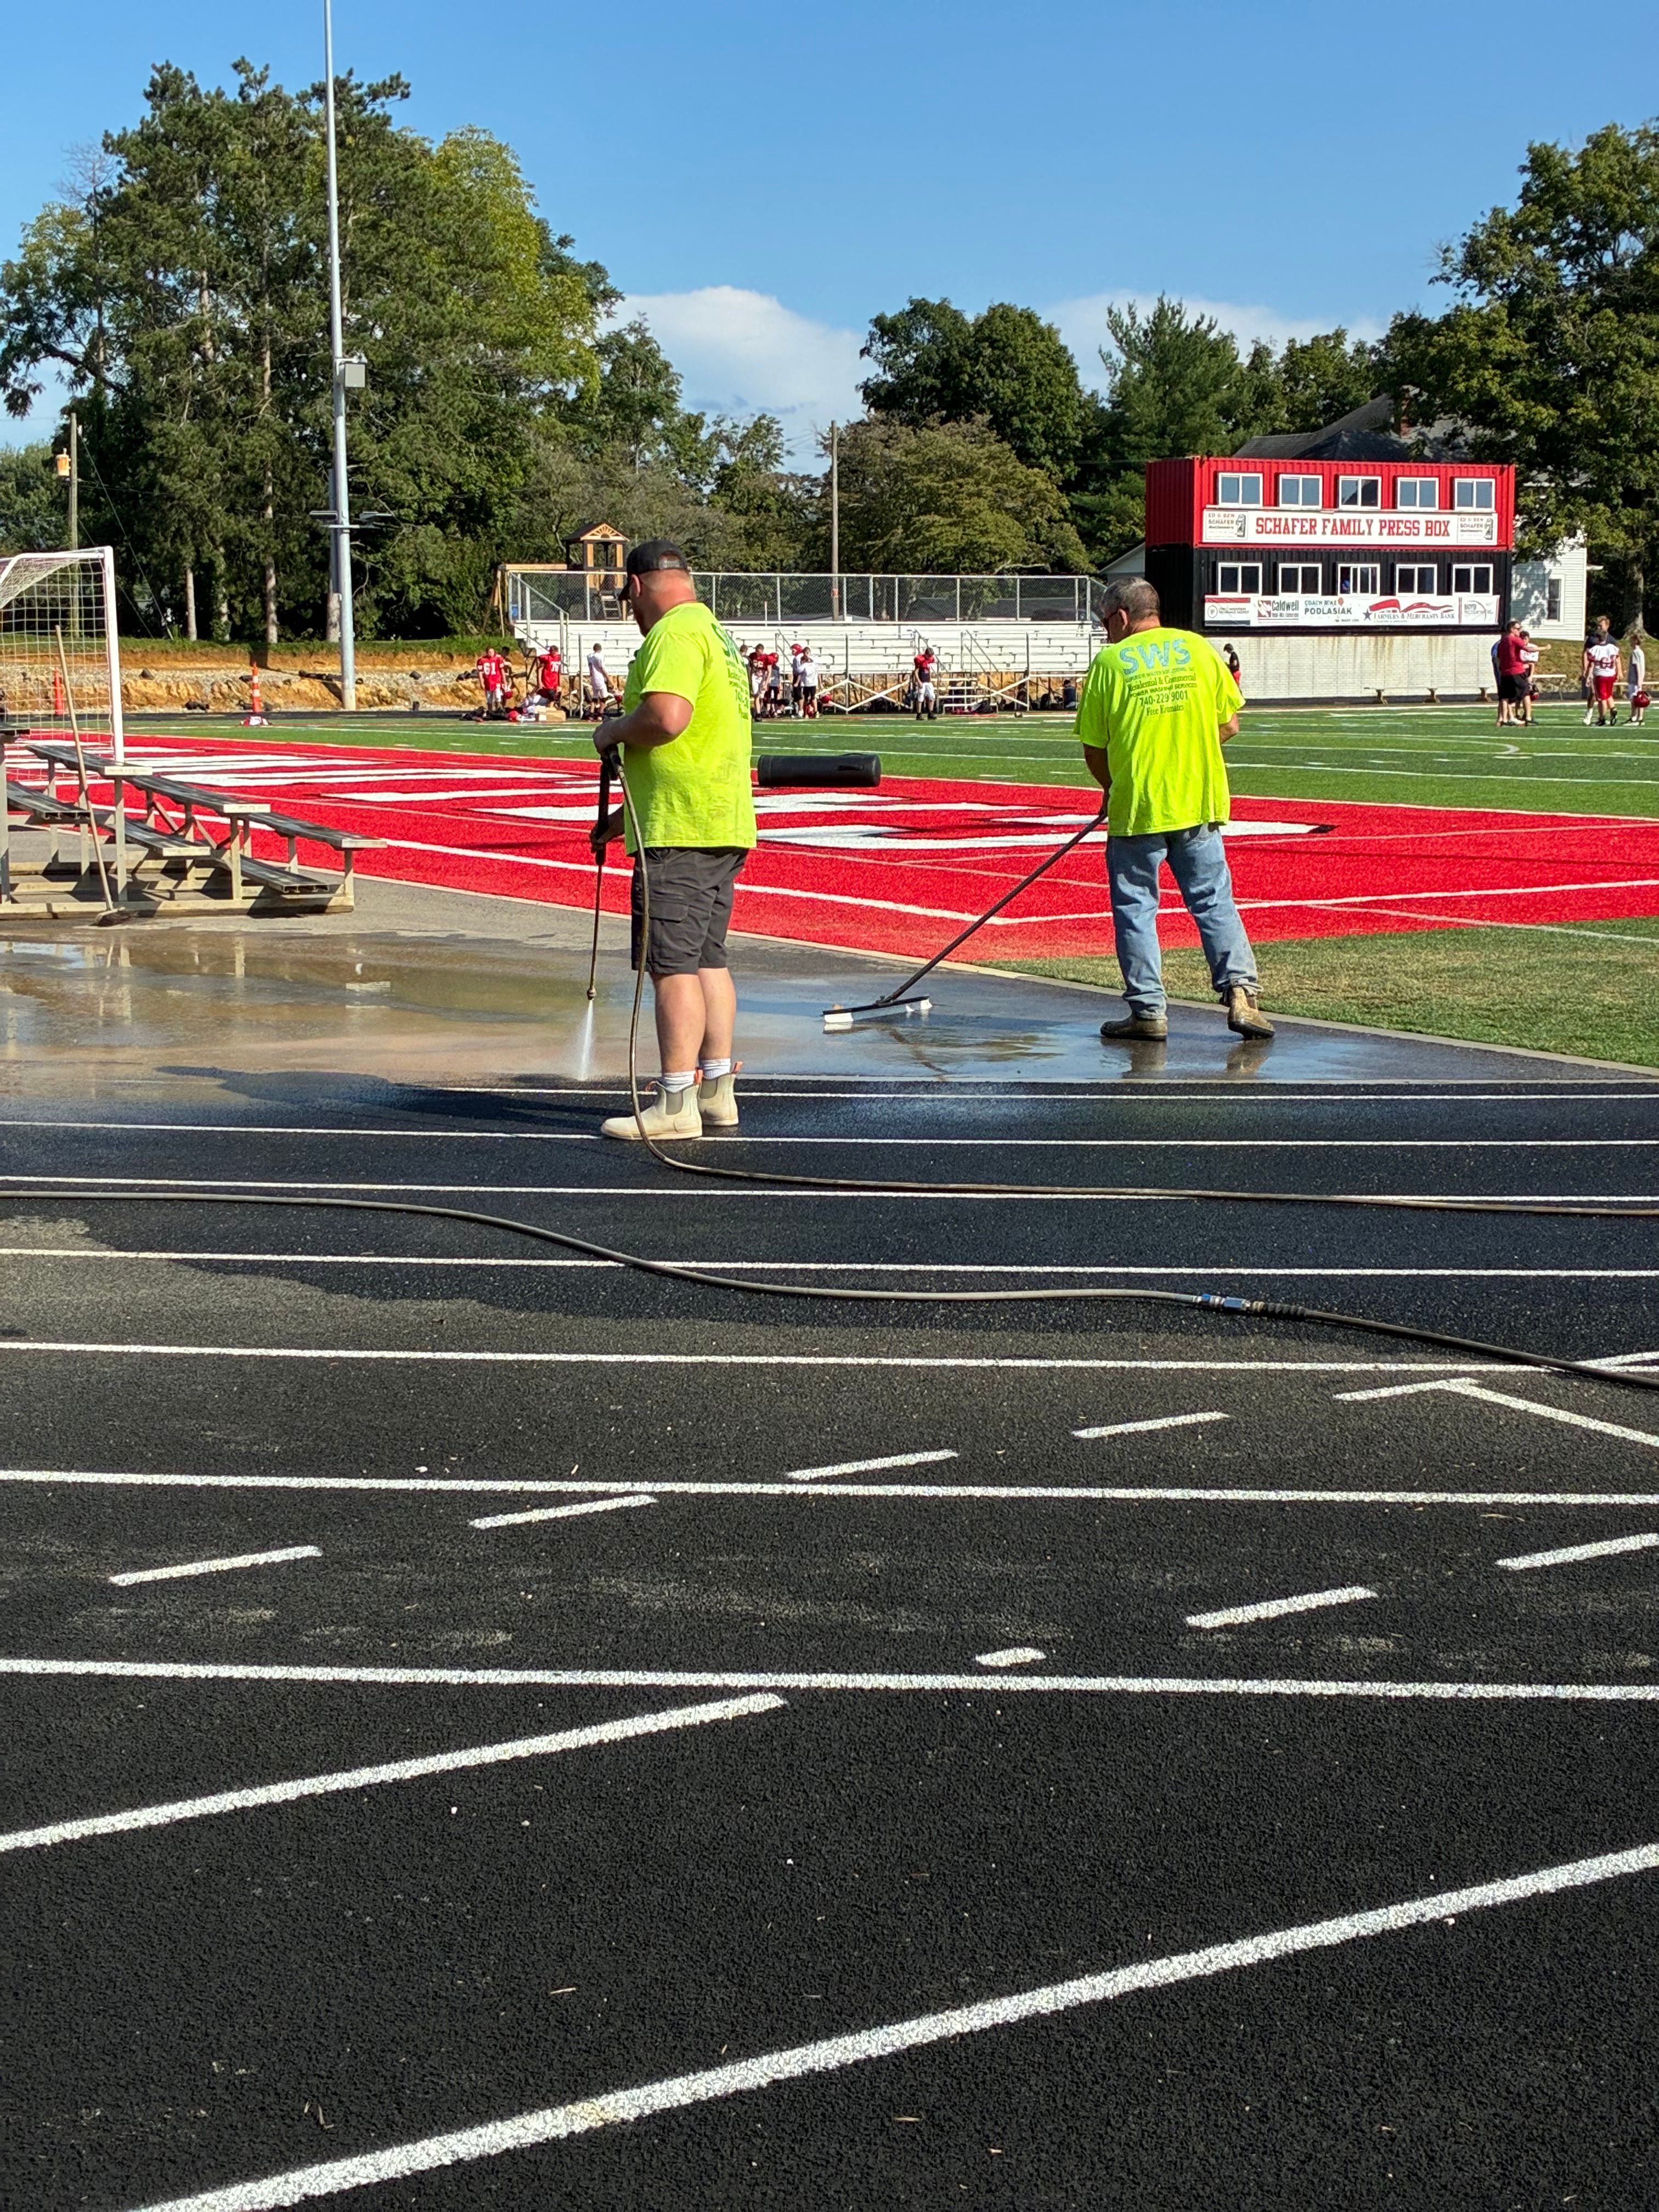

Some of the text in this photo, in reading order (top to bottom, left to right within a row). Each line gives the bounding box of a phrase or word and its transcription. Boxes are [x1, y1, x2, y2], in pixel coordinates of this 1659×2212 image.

[1255, 517, 1450, 537] SCHAFER FAMILY PRESS BOX
[1272, 600, 1299, 611] Caldwell
[1120, 638, 1191, 675] SWS
[483, 662, 496, 675] 61
[1127, 677, 1158, 692] Residential
[1165, 673, 1196, 684] Commercial
[1139, 690, 1188, 707] 740-2299001
